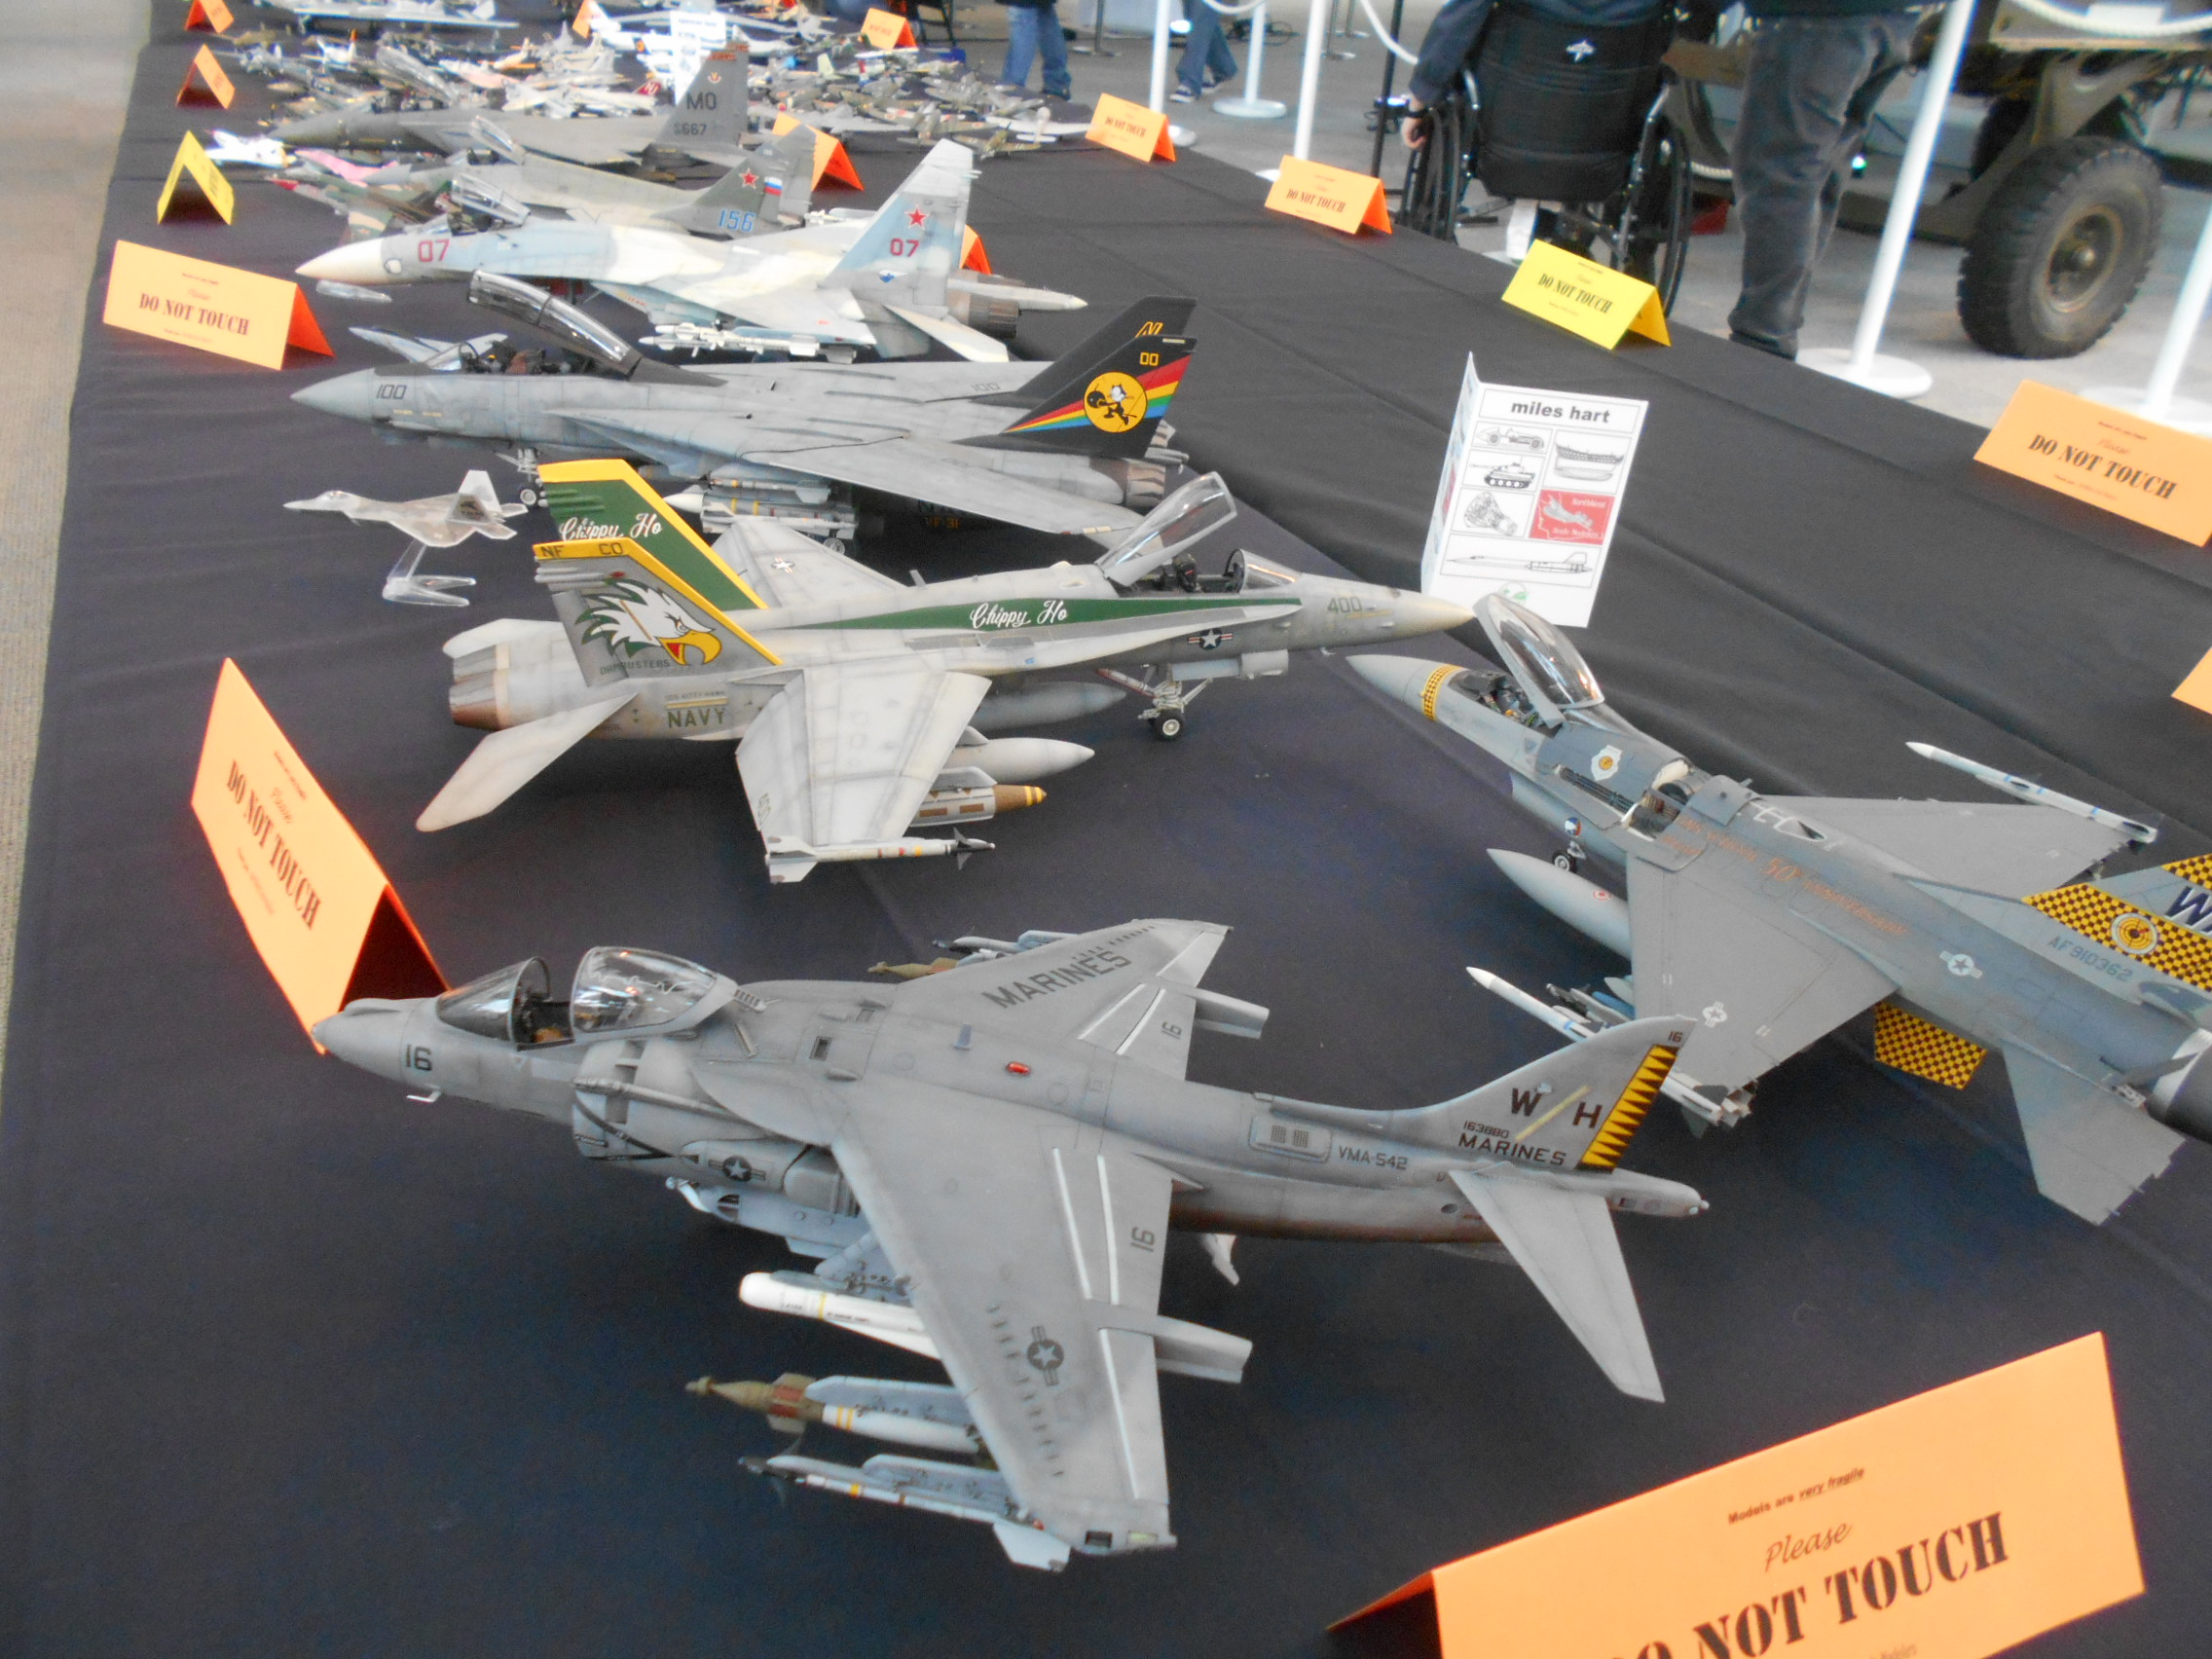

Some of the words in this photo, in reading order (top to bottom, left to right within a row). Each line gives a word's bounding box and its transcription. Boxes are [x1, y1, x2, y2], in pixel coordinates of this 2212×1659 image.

[686, 92, 717, 110] MO
[1286, 188, 1299, 201] DO
[1300, 191, 1316, 204] NOT
[1316, 196, 1346, 213] TOUCH
[719, 208, 756, 233] 156
[418, 239, 451, 263] 07
[890, 238, 919, 257] 07
[1537, 273, 1554, 288] DO
[1553, 279, 1577, 300] NOT
[1574, 287, 1613, 313] TOUCH
[139, 292, 160, 313] DO
[163, 298, 195, 321] NOT
[197, 306, 250, 336] TOUCH
[375, 384, 407, 400] 100
[1510, 401, 1564, 419] miles
[1568, 405, 1610, 424] hart
[2028, 434, 2058, 457] DO
[2057, 444, 2103, 472] NOT
[2103, 460, 2178, 500] TOUCH
[629, 512, 663, 538] Ho
[540, 545, 564, 558] NF
[970, 602, 1031, 629] Chippy
[1036, 600, 1068, 624] Ho
[1327, 596, 1362, 613] 400
[667, 707, 725, 729] NAVY
[227, 758, 246, 805] DO
[242, 789, 274, 849] NOT
[270, 833, 321, 930] TOUCH
[981, 950, 1132, 1009] MARINES
[1161, 1020, 1183, 1040] 16
[1667, 1030, 1684, 1043] 16
[405, 1044, 432, 1072] 16
[1510, 1087, 1543, 1118] W
[1572, 1101, 1603, 1128] H
[1338, 1144, 1409, 1170] VMA-542
[1457, 1132, 1567, 1166] MARINES
[1129, 1225, 1156, 1253] 16
[1727, 1502, 1772, 1525] Models
[1775, 1493, 1794, 1508] are
[1798, 1482, 1825, 1500] very
[1827, 1467, 1865, 1488] fragile
[1764, 1522, 1854, 1573] Please
[1692, 1586, 1808, 1659] NOT
[1825, 1510, 2009, 1625] TOUCH
